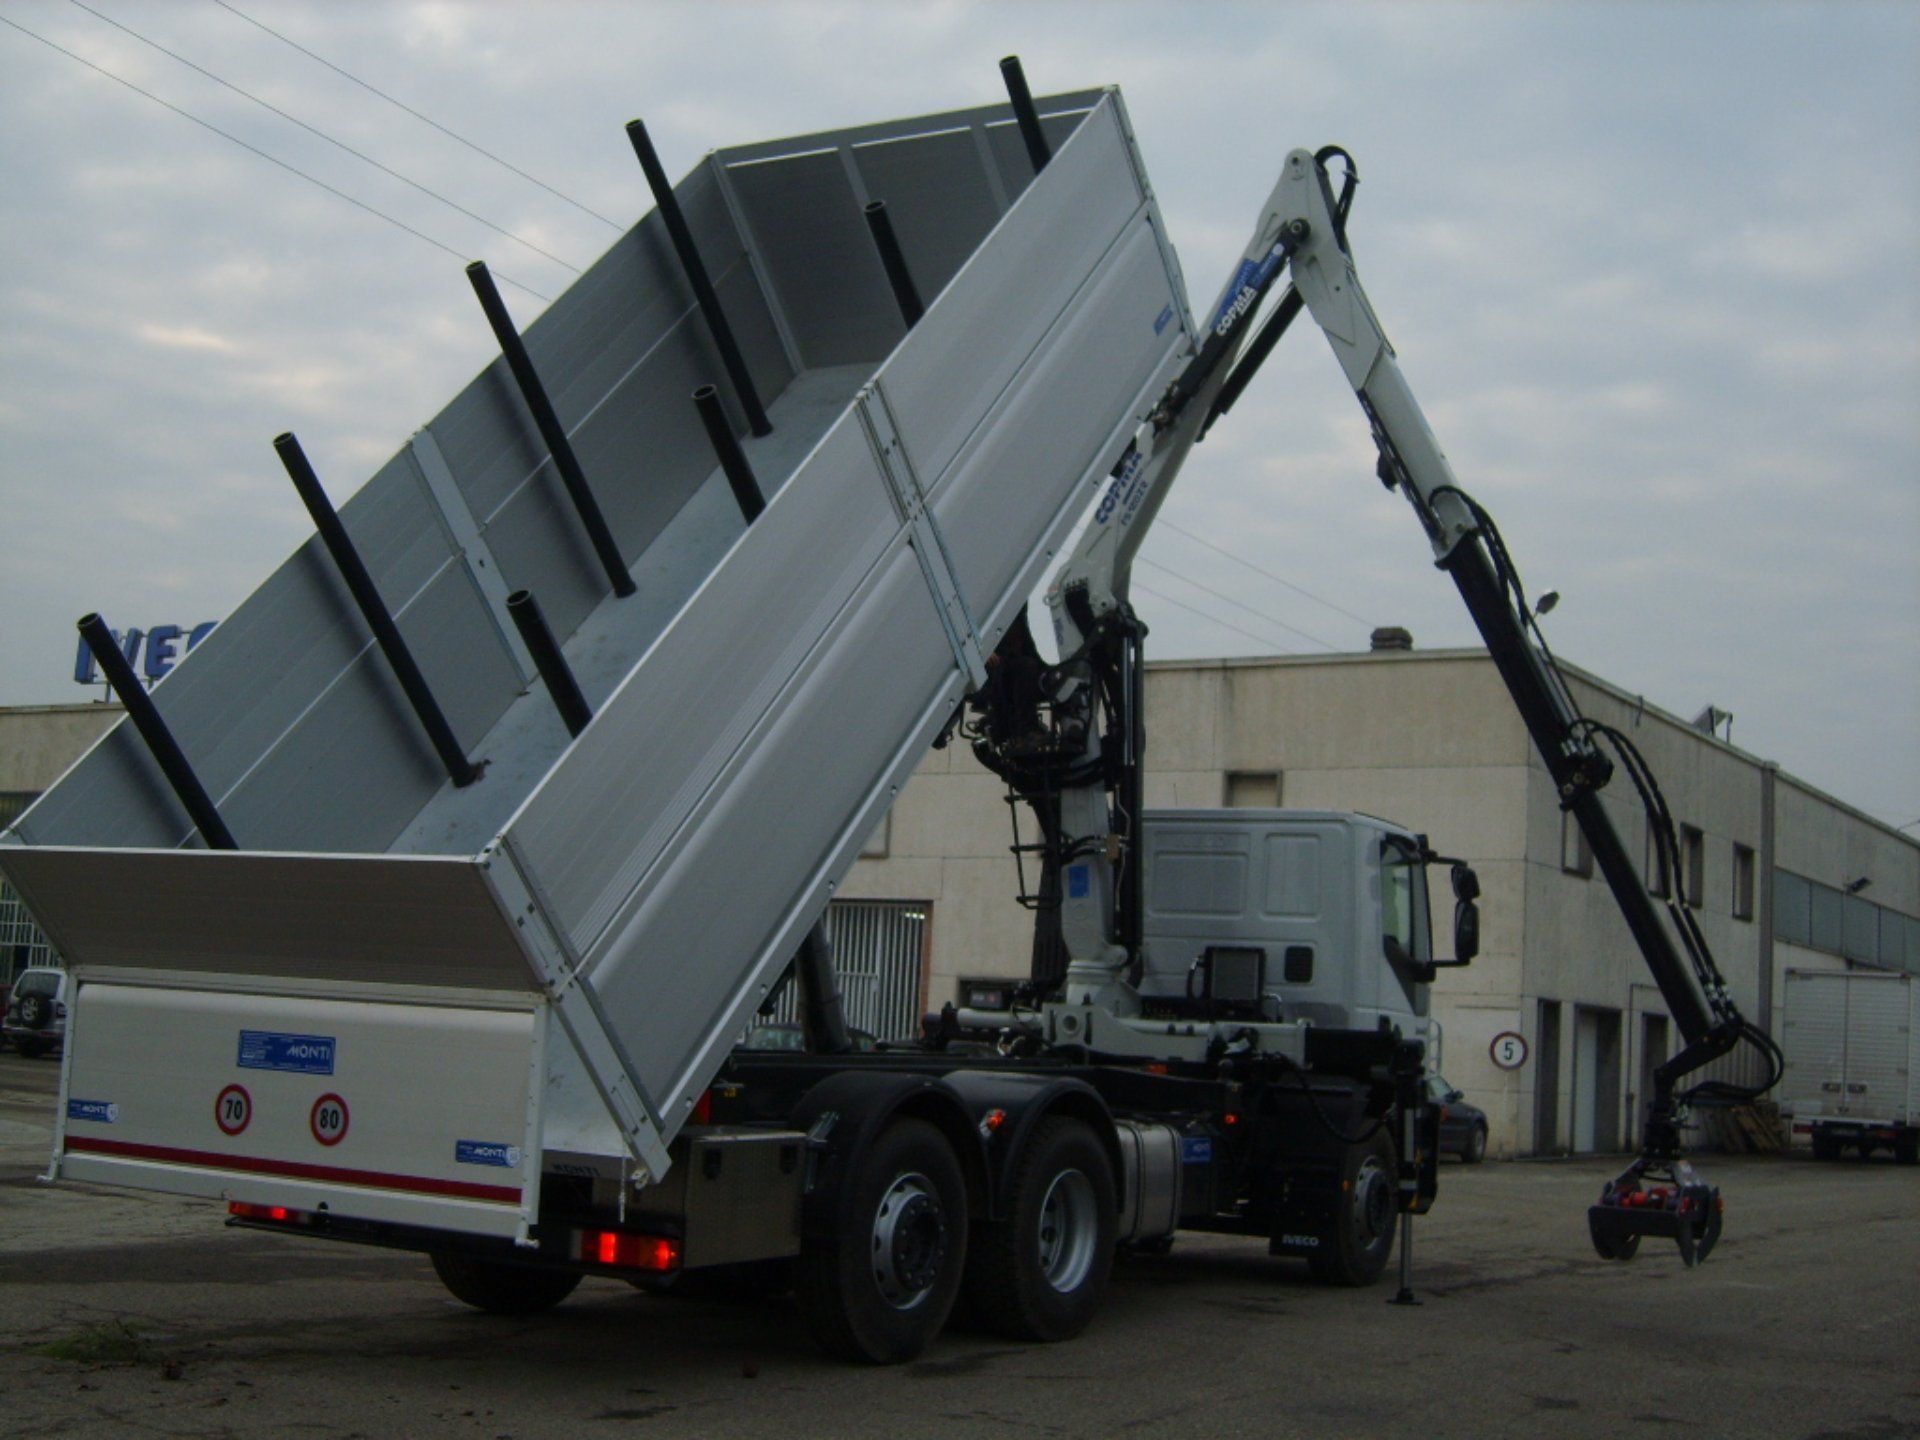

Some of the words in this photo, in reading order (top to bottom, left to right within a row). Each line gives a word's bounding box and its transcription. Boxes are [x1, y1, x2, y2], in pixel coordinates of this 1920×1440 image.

[1216, 285, 1258, 337] COPMA
[285, 1043, 331, 1060] MONTI
[1503, 1041, 1514, 1061] 5
[225, 1099, 243, 1120] 70
[319, 1108, 340, 1130] 80
[473, 1146, 505, 1158] MONTI
[1282, 1233, 1319, 1247] IVECO
